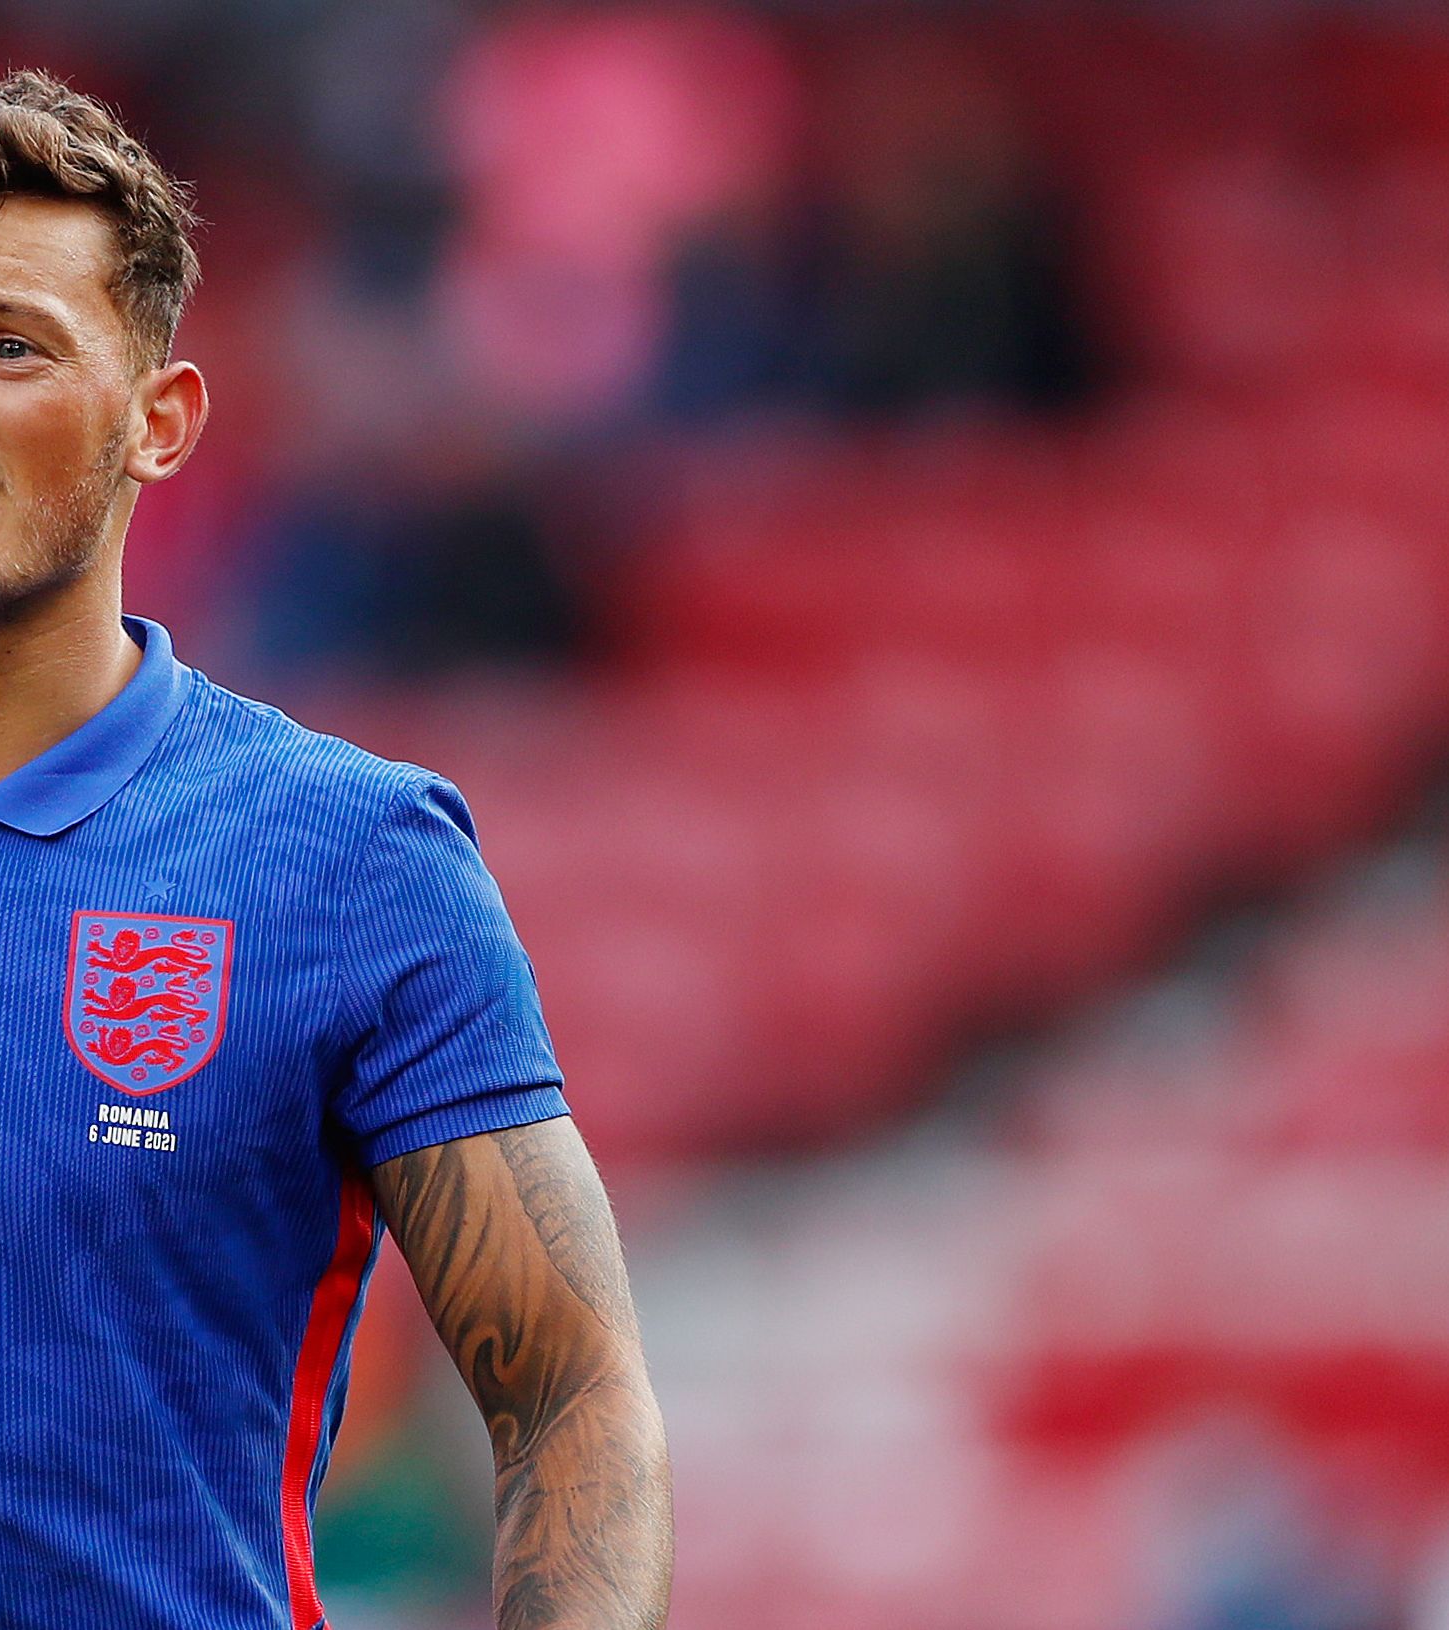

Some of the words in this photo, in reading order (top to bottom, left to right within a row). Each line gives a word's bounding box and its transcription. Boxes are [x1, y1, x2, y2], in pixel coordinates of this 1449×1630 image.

[99, 1104, 169, 1129] ROMANIA
[89, 1124, 98, 1142] 6
[102, 1126, 142, 1147] JUNE
[145, 1131, 176, 1152] 2021
